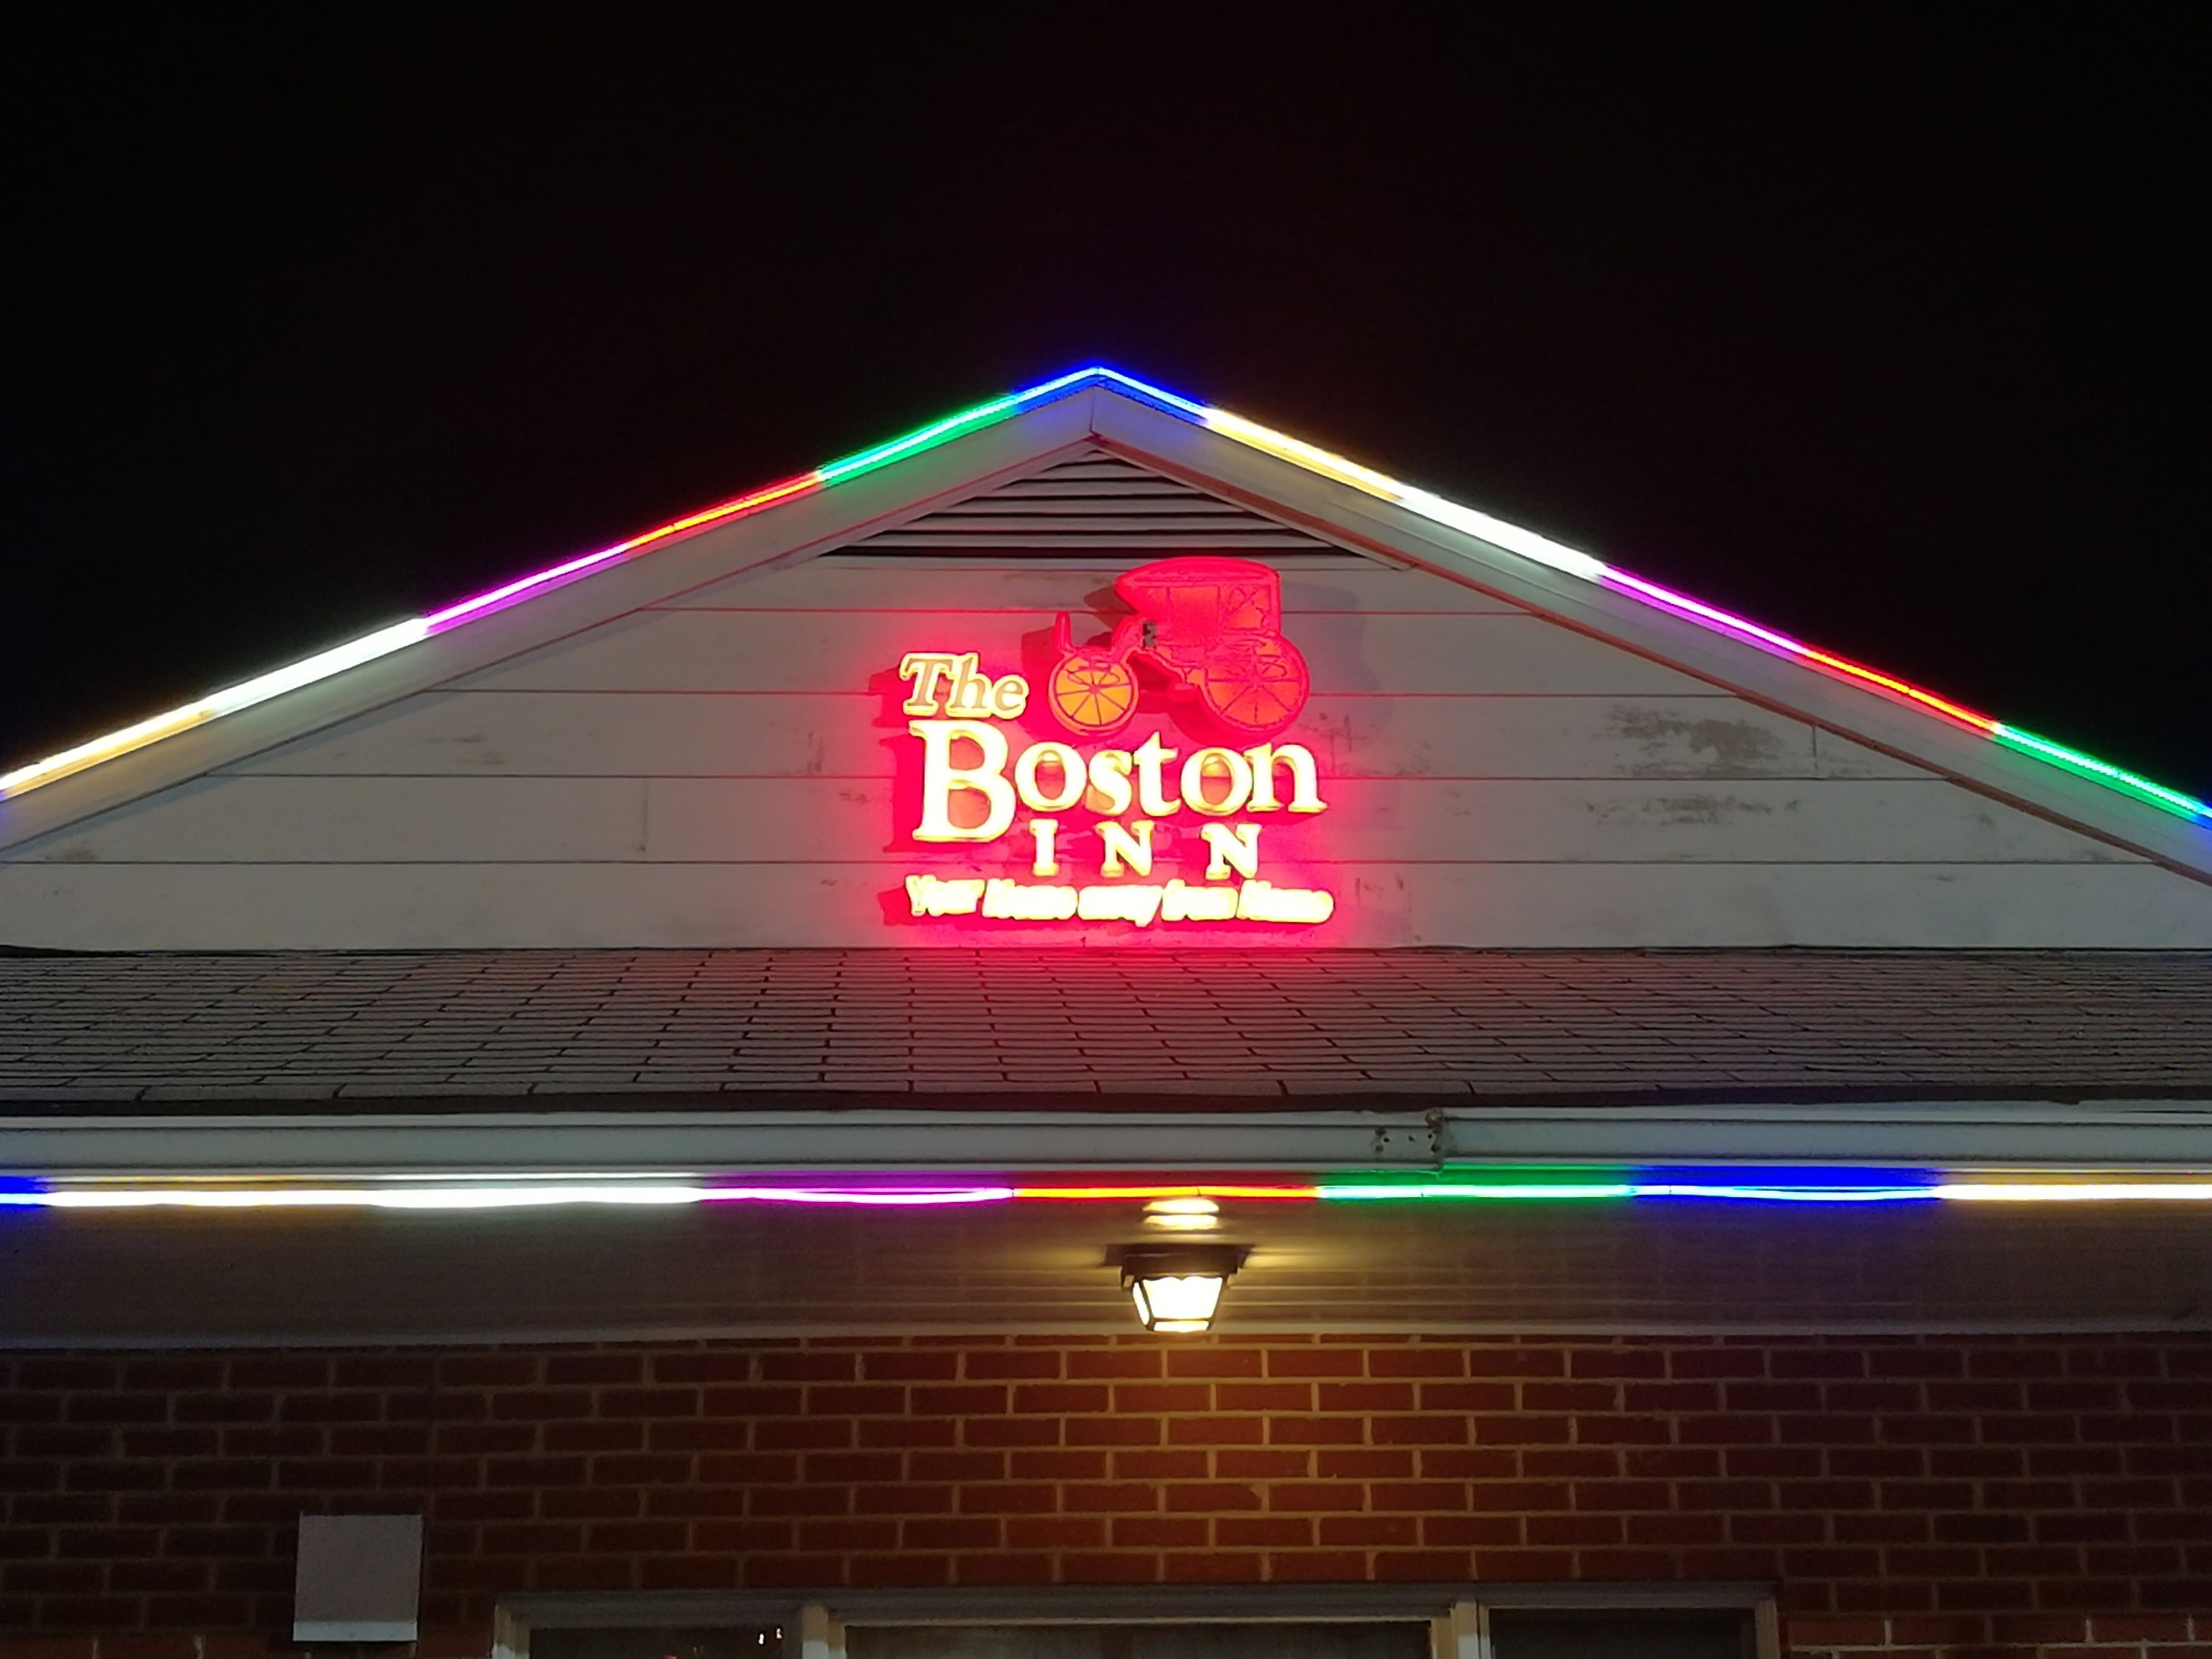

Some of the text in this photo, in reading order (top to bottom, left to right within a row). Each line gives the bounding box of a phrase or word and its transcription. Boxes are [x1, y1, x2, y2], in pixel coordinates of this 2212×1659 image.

[900, 653, 1029, 719] The
[908, 720, 1327, 842] Boston
[1030, 819, 1262, 880] INN
